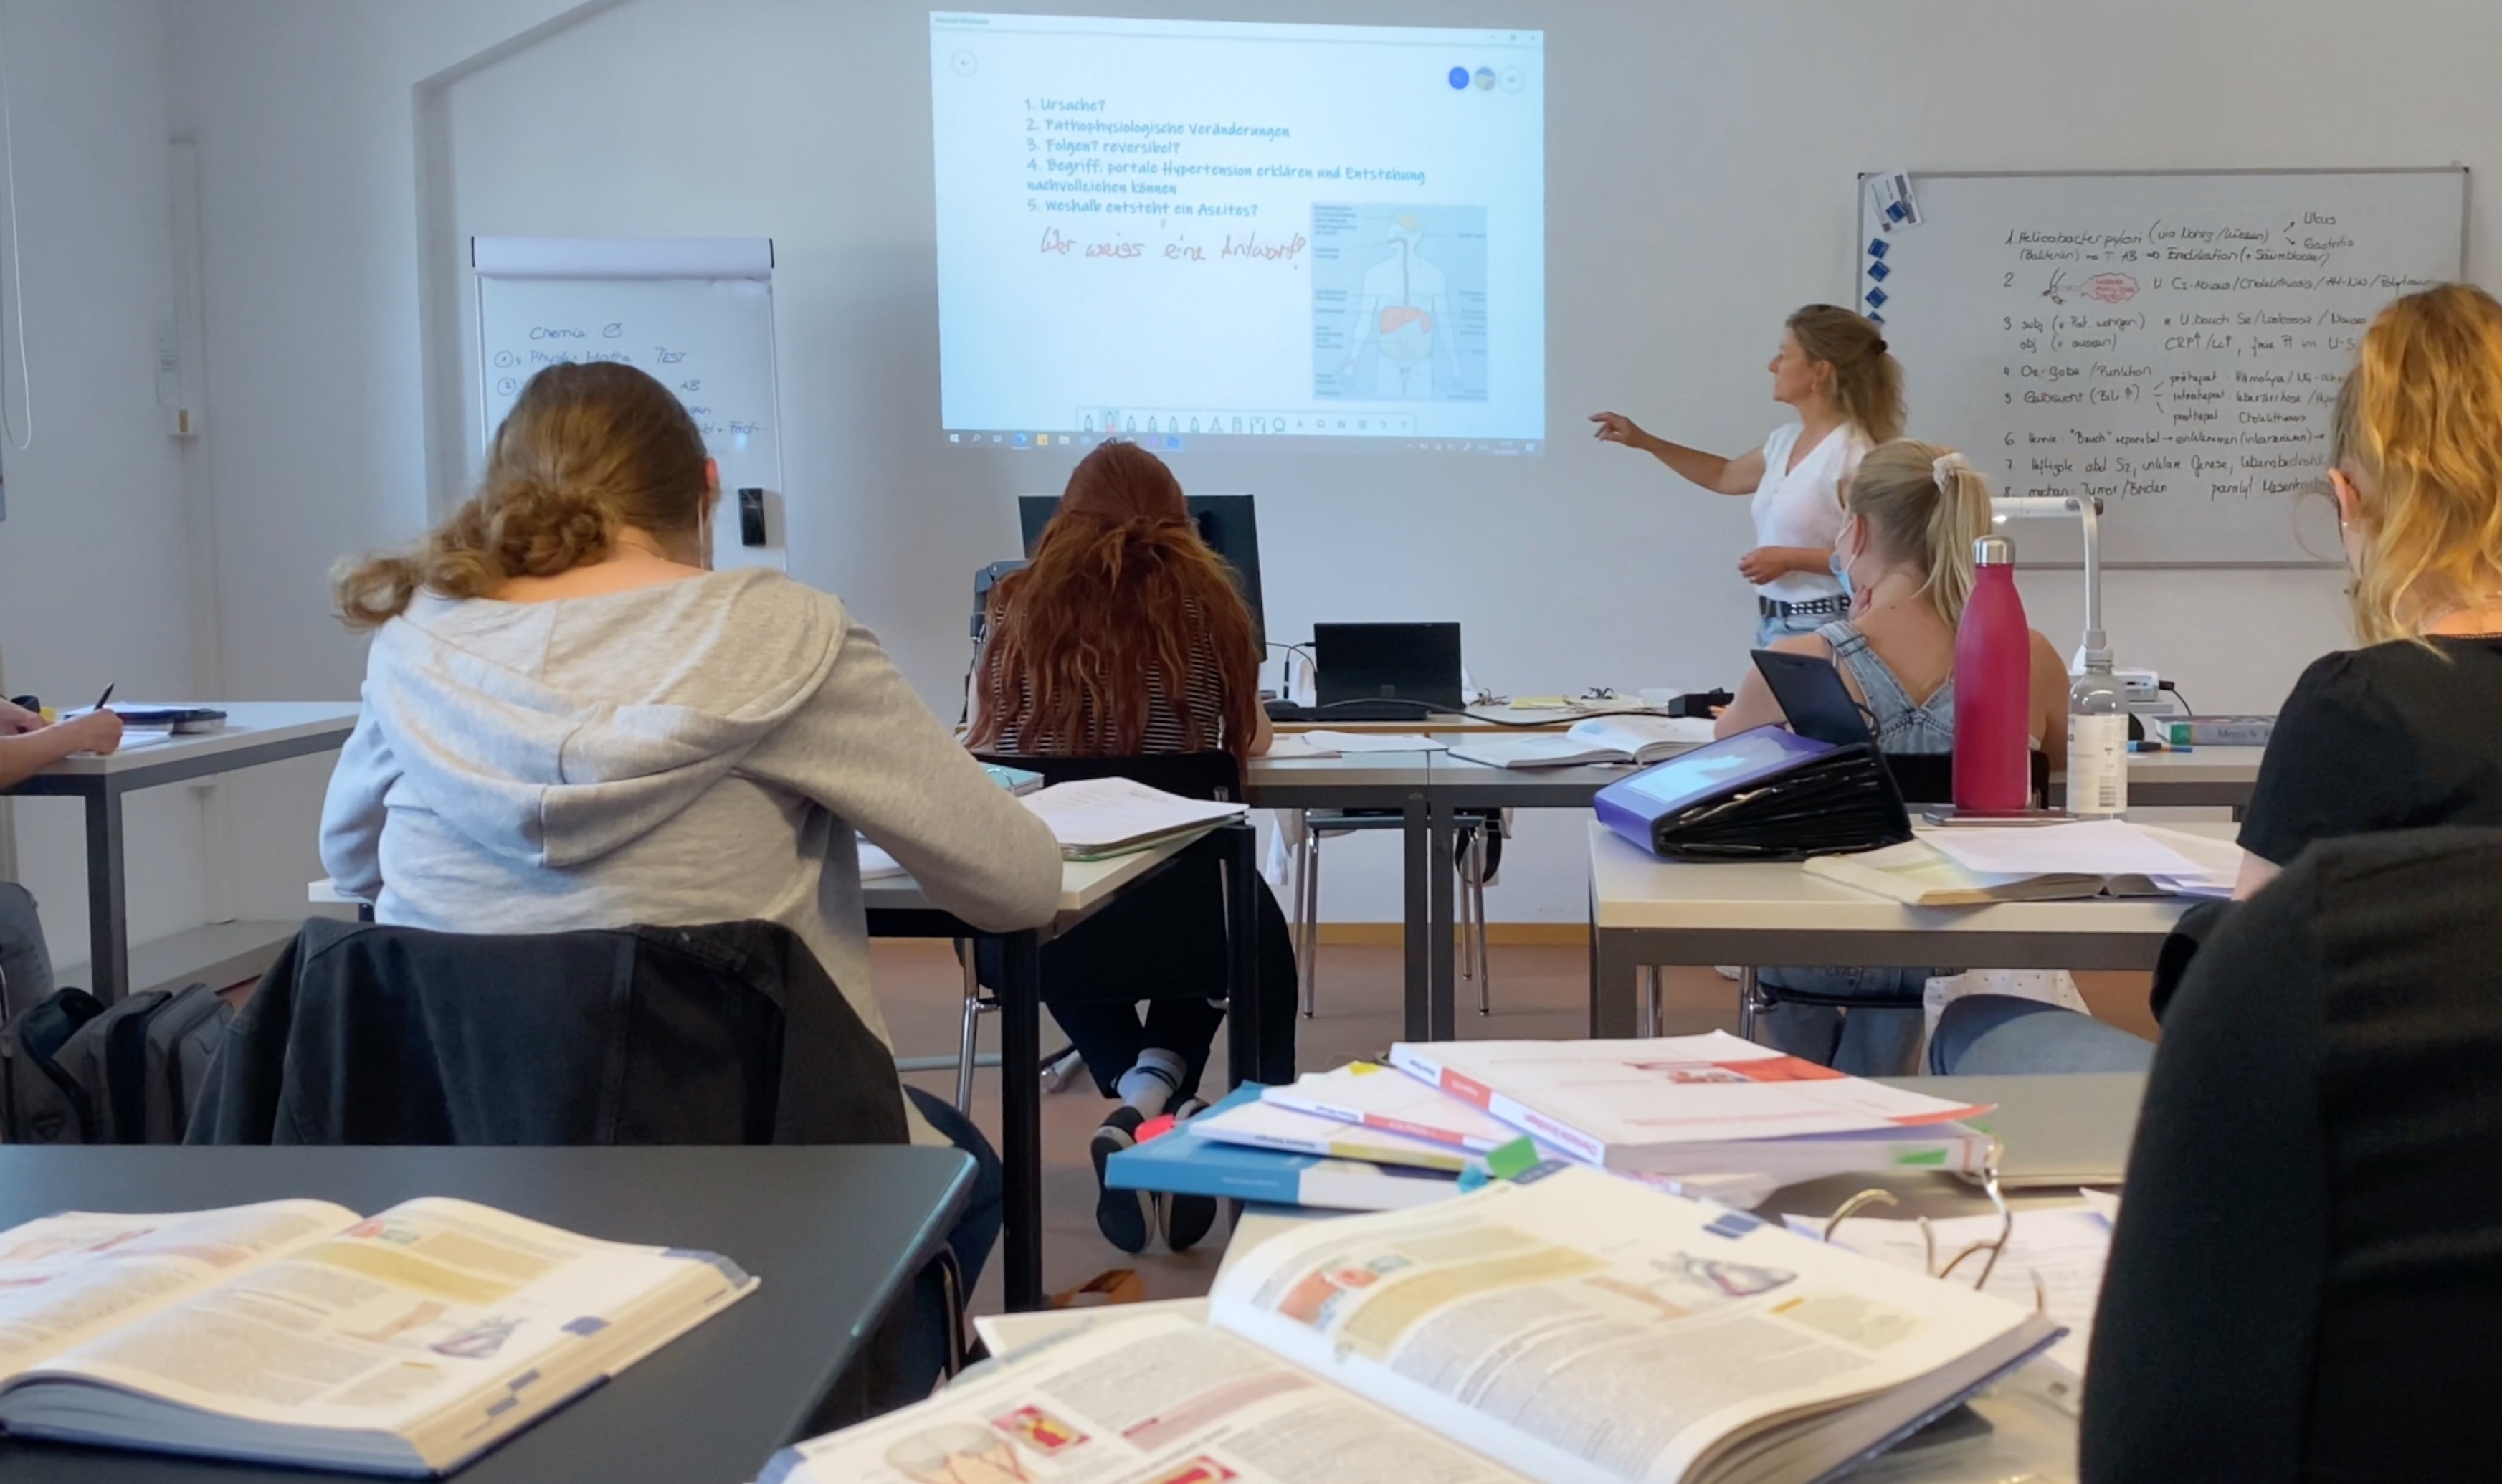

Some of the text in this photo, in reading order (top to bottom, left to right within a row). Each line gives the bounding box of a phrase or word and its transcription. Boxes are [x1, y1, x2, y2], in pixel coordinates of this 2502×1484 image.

[1024, 97, 1106, 113] 1. Ursache?
[1045, 118, 1185, 139] Pathophysiologische
[1189, 121, 1290, 143] Veränderungen
[1046, 138, 1100, 157] Folgen?
[1103, 140, 1181, 155] reversibel?
[1108, 162, 1159, 176] portale
[1162, 159, 1252, 179] Hypertension
[1257, 163, 1313, 179] erklären
[1317, 166, 1341, 180] und
[1345, 166, 1427, 186] Entstehung
[1027, 178, 1177, 195] nachvollziehen können
[1045, 199, 1103, 213] Weshalb
[1106, 200, 1171, 215] entsteht
[1174, 204, 1194, 216] ein
[1040, 227, 1076, 255] Wer
[1085, 233, 1146, 259] weiss
[1164, 235, 1207, 261] eine
[2018, 231, 2103, 246] Helicobacter
[2103, 229, 2143, 248] pylori
[2121, 249, 2139, 262] AB
